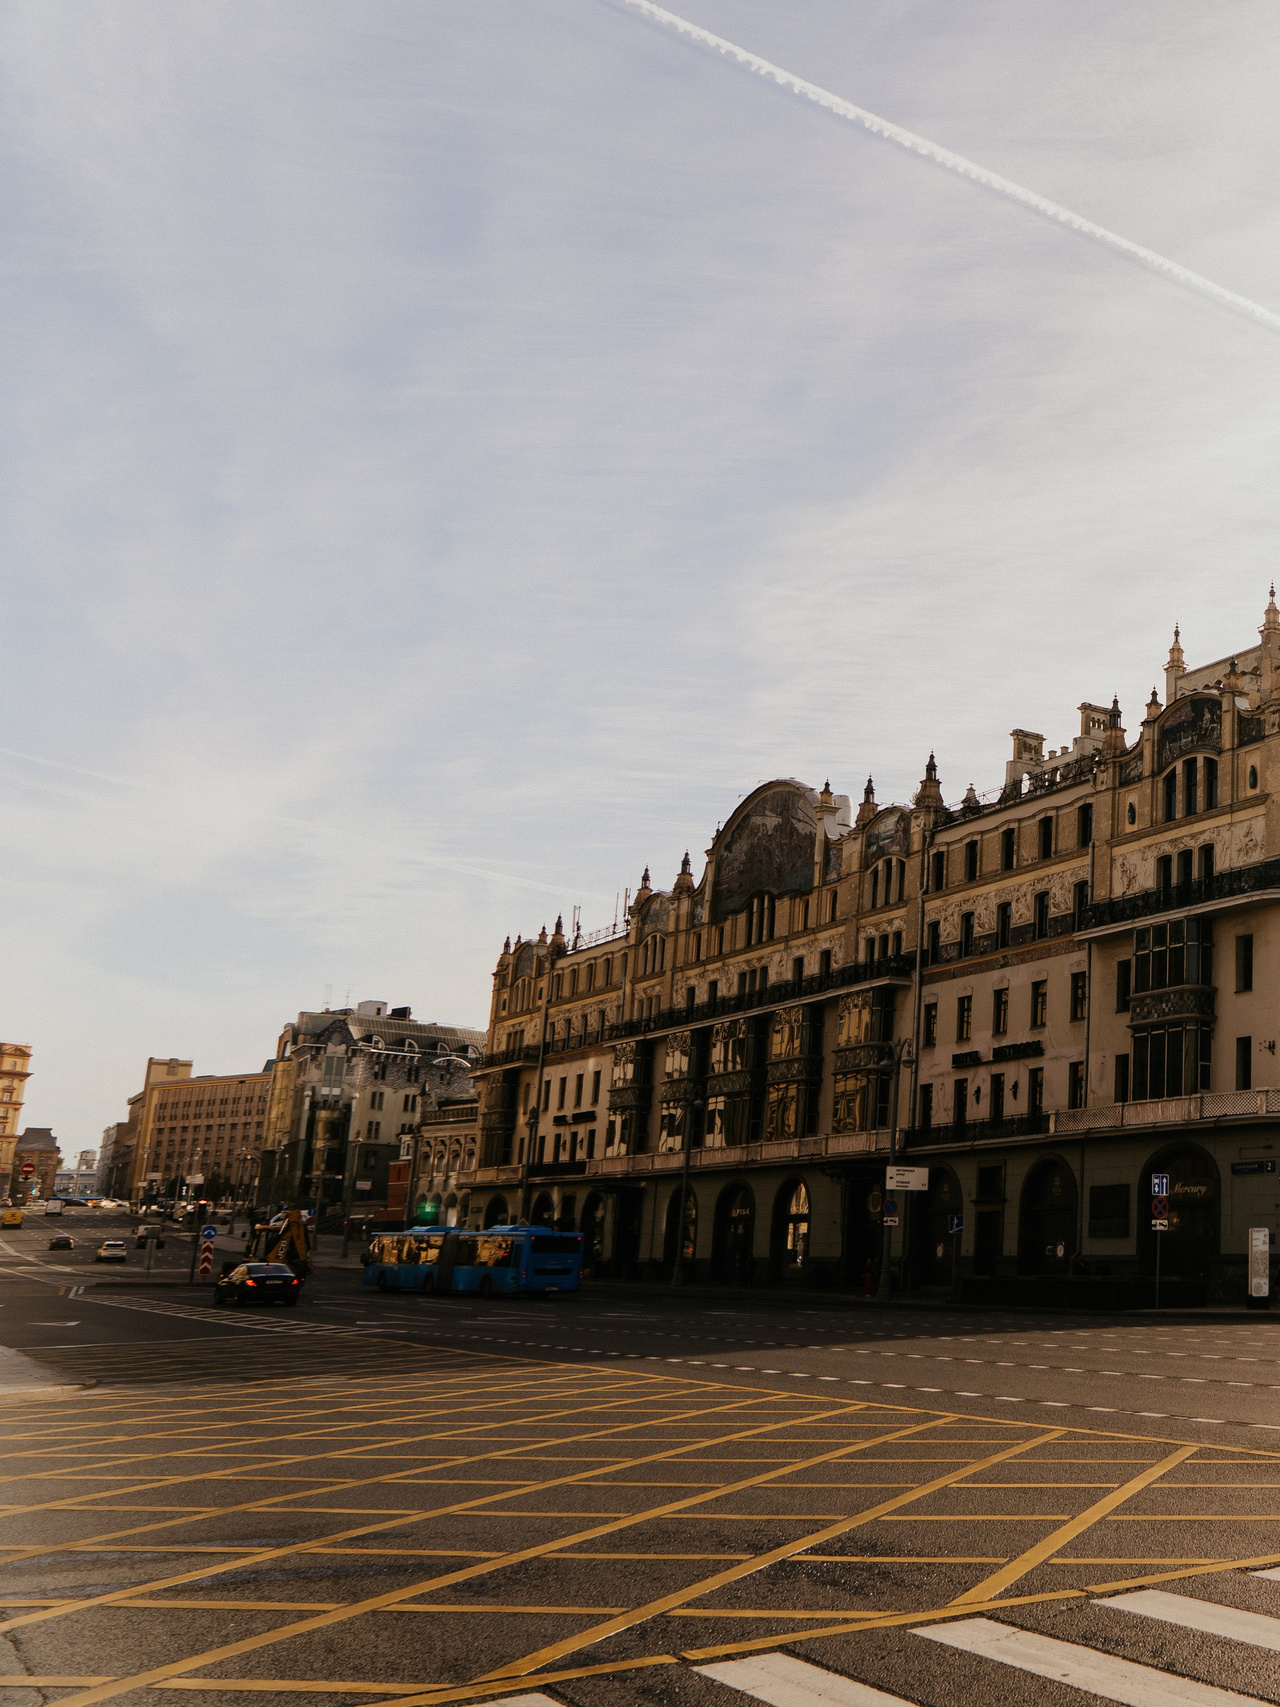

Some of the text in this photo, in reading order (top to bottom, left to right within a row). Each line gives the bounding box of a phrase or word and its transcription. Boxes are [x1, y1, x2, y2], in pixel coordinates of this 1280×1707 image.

[1266, 1162, 1273, 1171] 2
[1170, 1181, 1207, 1197] Mercury
[276, 1240, 288, 1260] JCB
